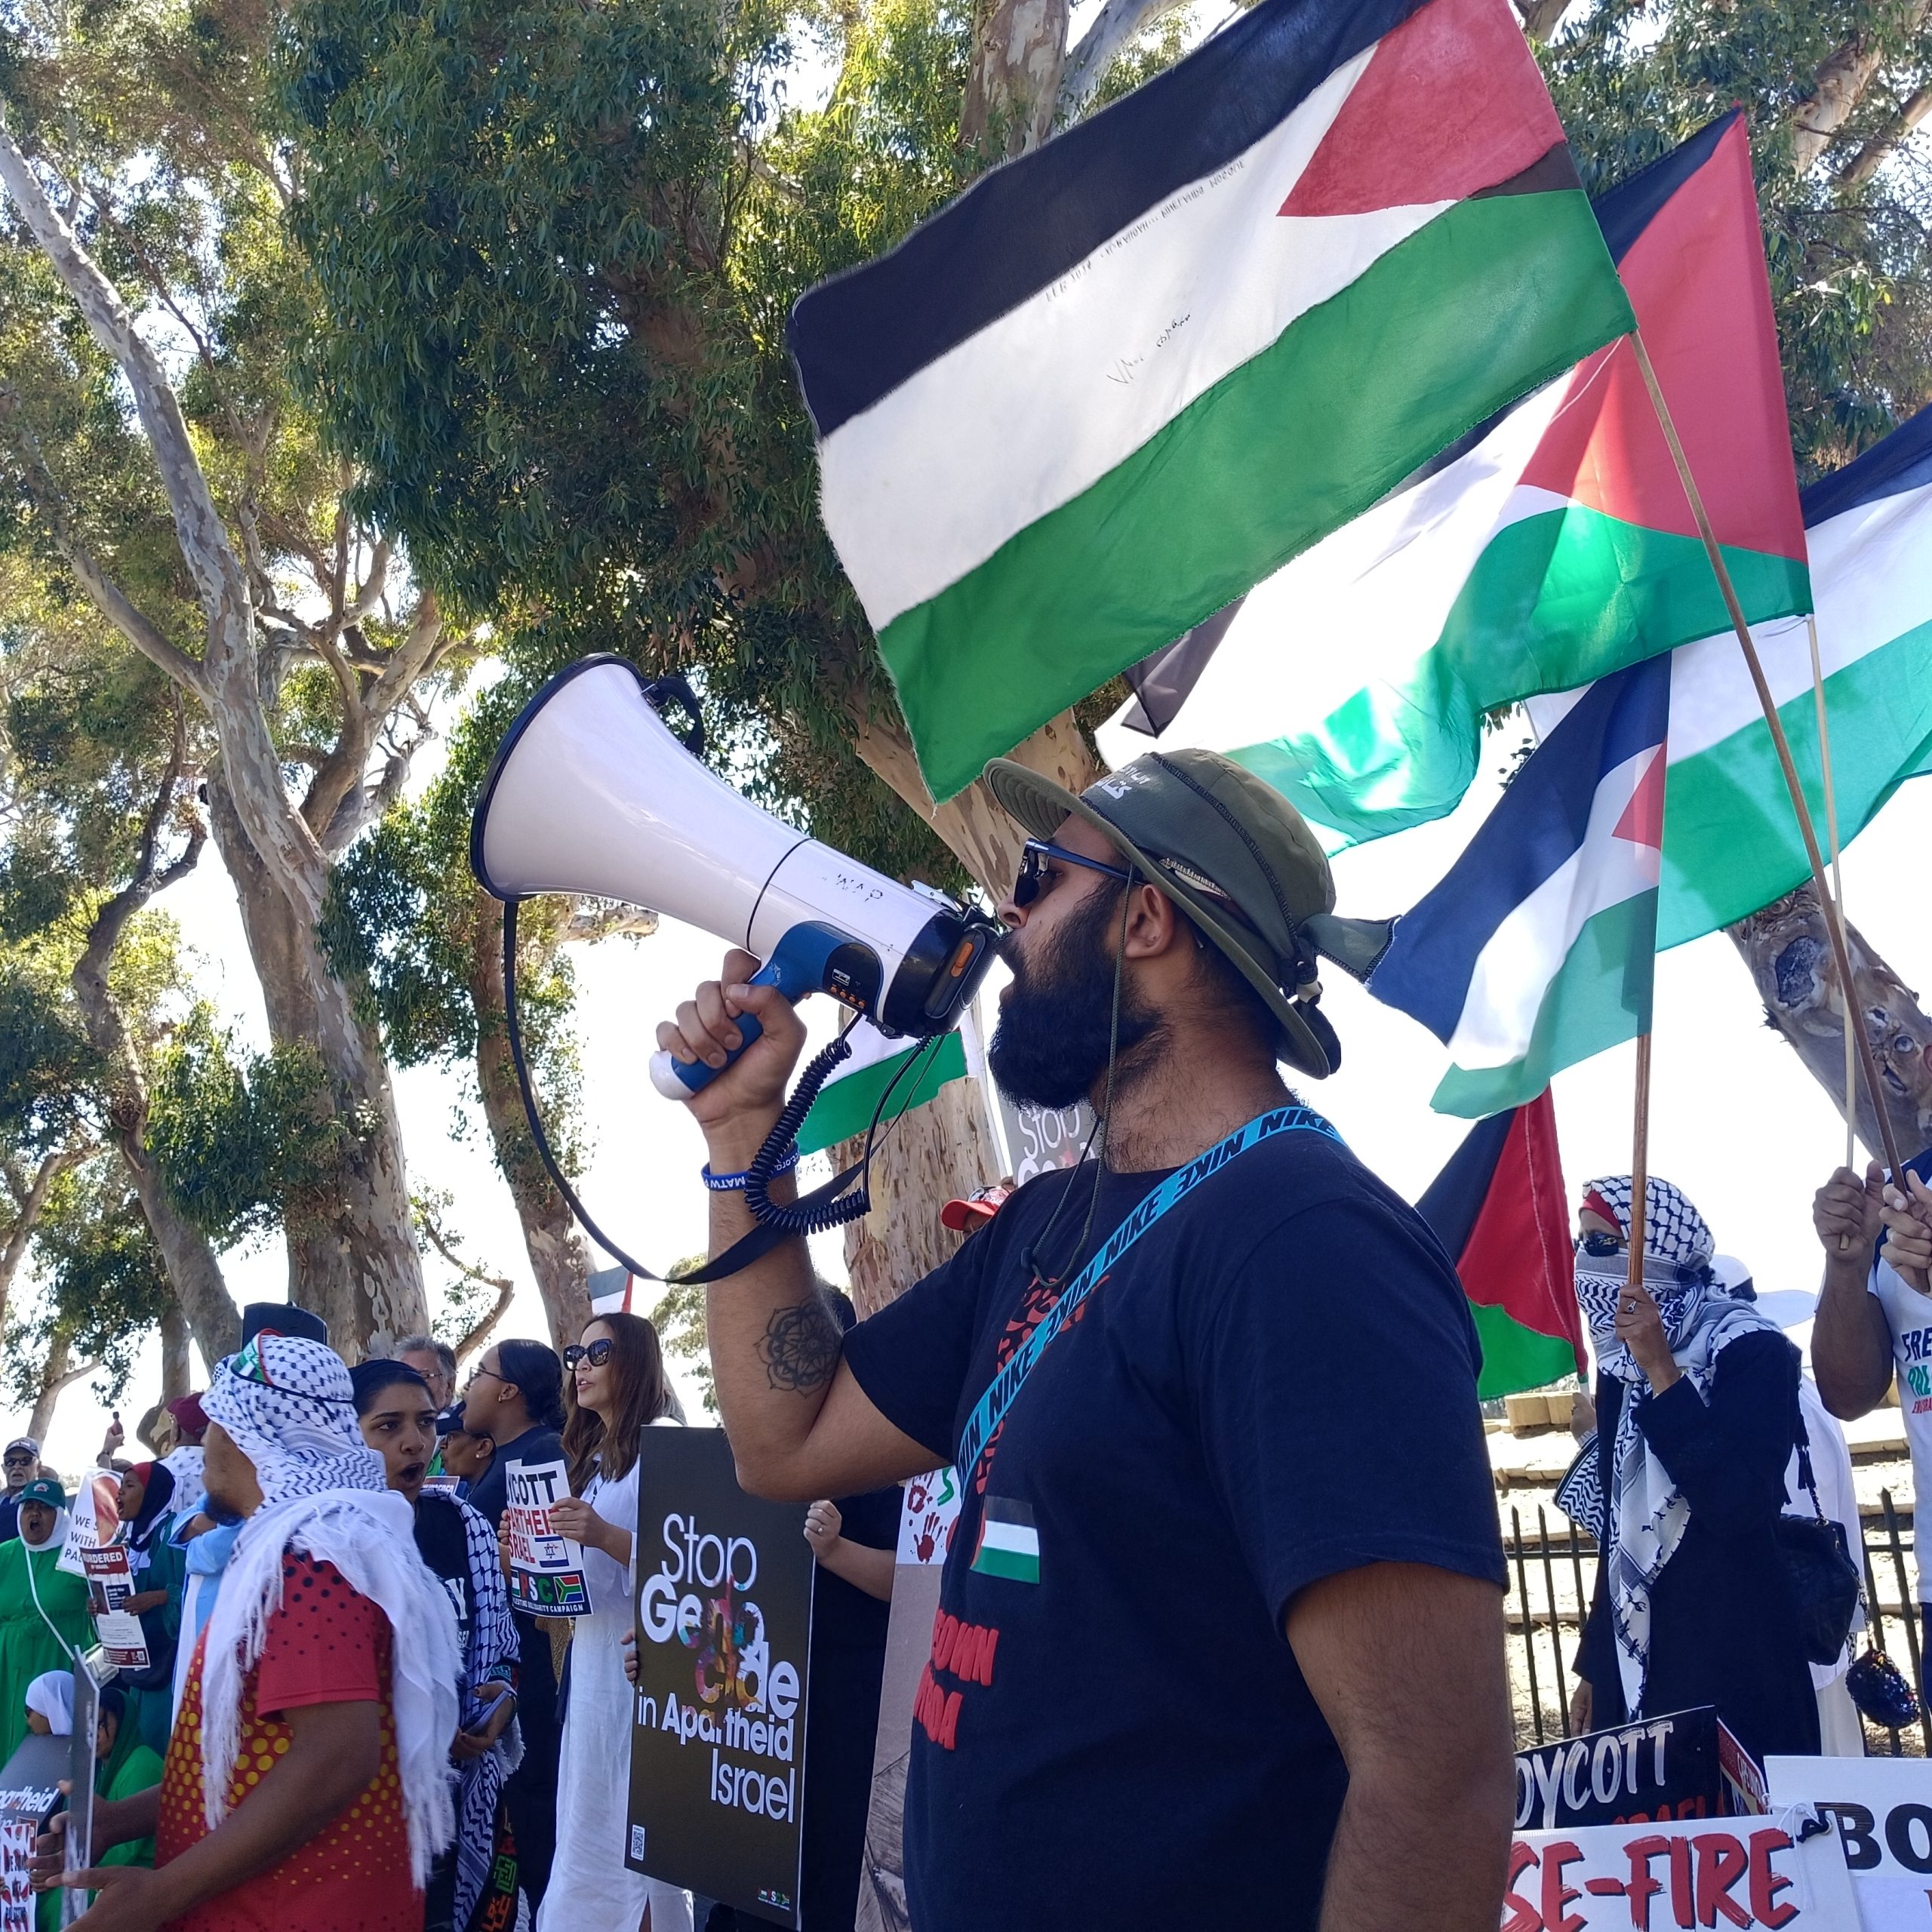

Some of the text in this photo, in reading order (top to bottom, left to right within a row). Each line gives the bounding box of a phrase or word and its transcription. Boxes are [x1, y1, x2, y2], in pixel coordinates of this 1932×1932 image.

[1257, 1109, 1337, 1139] NIKE
[1171, 1130, 1245, 1201] NIKE
[1101, 1187, 1163, 1272] NIKE
[1902, 1327, 1932, 1362] FRE
[988, 1335, 1038, 1429] NIKE
[1908, 1364, 1931, 1398] PAL
[71, 1531, 97, 1548] WITH
[75, 1515, 91, 1528] WE
[509, 1532, 536, 1564] SRAEL
[661, 1513, 757, 1591] Stop
[519, 1574, 554, 1603] PSC
[549, 1604, 583, 1613] CAMPAIGN
[638, 1686, 657, 1728] in
[710, 1748, 795, 1823] Israel
[1514, 1720, 1674, 1829] OYCOTT
[1814, 1801, 1932, 1875] BO
[1500, 1827, 1801, 1932] SE-FIRE
